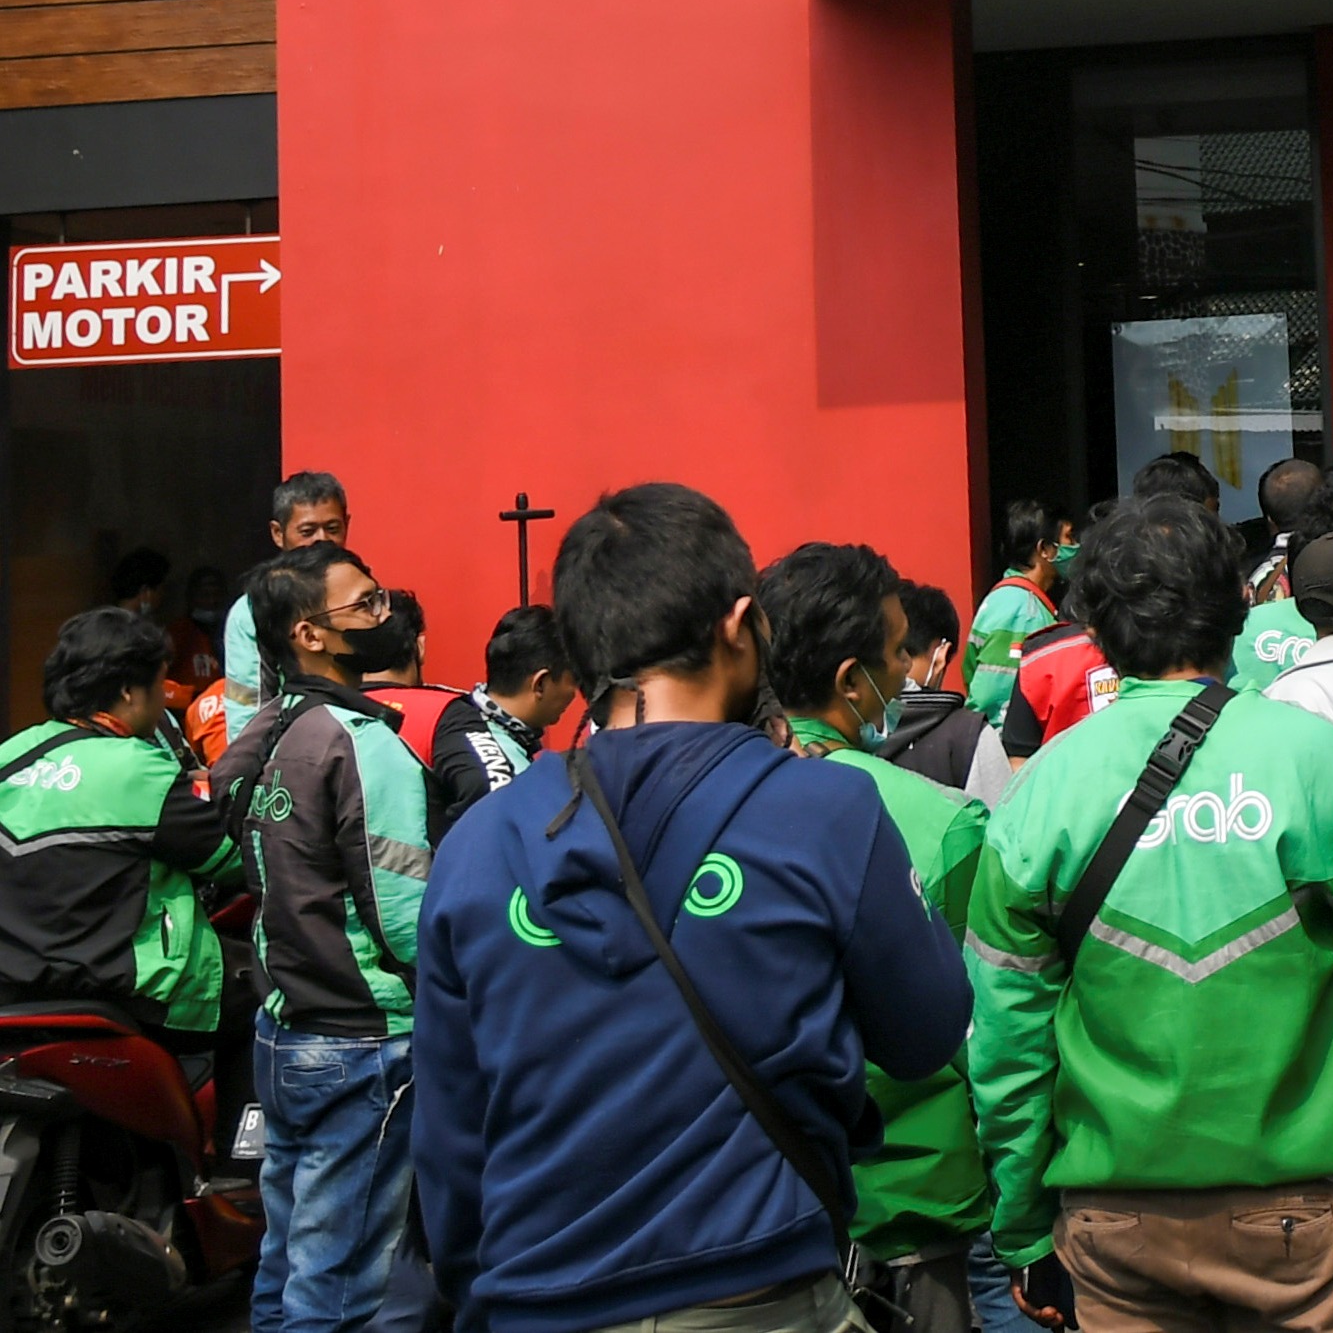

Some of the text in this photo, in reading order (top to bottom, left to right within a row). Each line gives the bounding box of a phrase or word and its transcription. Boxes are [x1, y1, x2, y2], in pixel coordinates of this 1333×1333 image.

[23, 255, 217, 301] PARKIR
[23, 304, 211, 350] MOTOR
[1254, 629, 1316, 666] Gra
